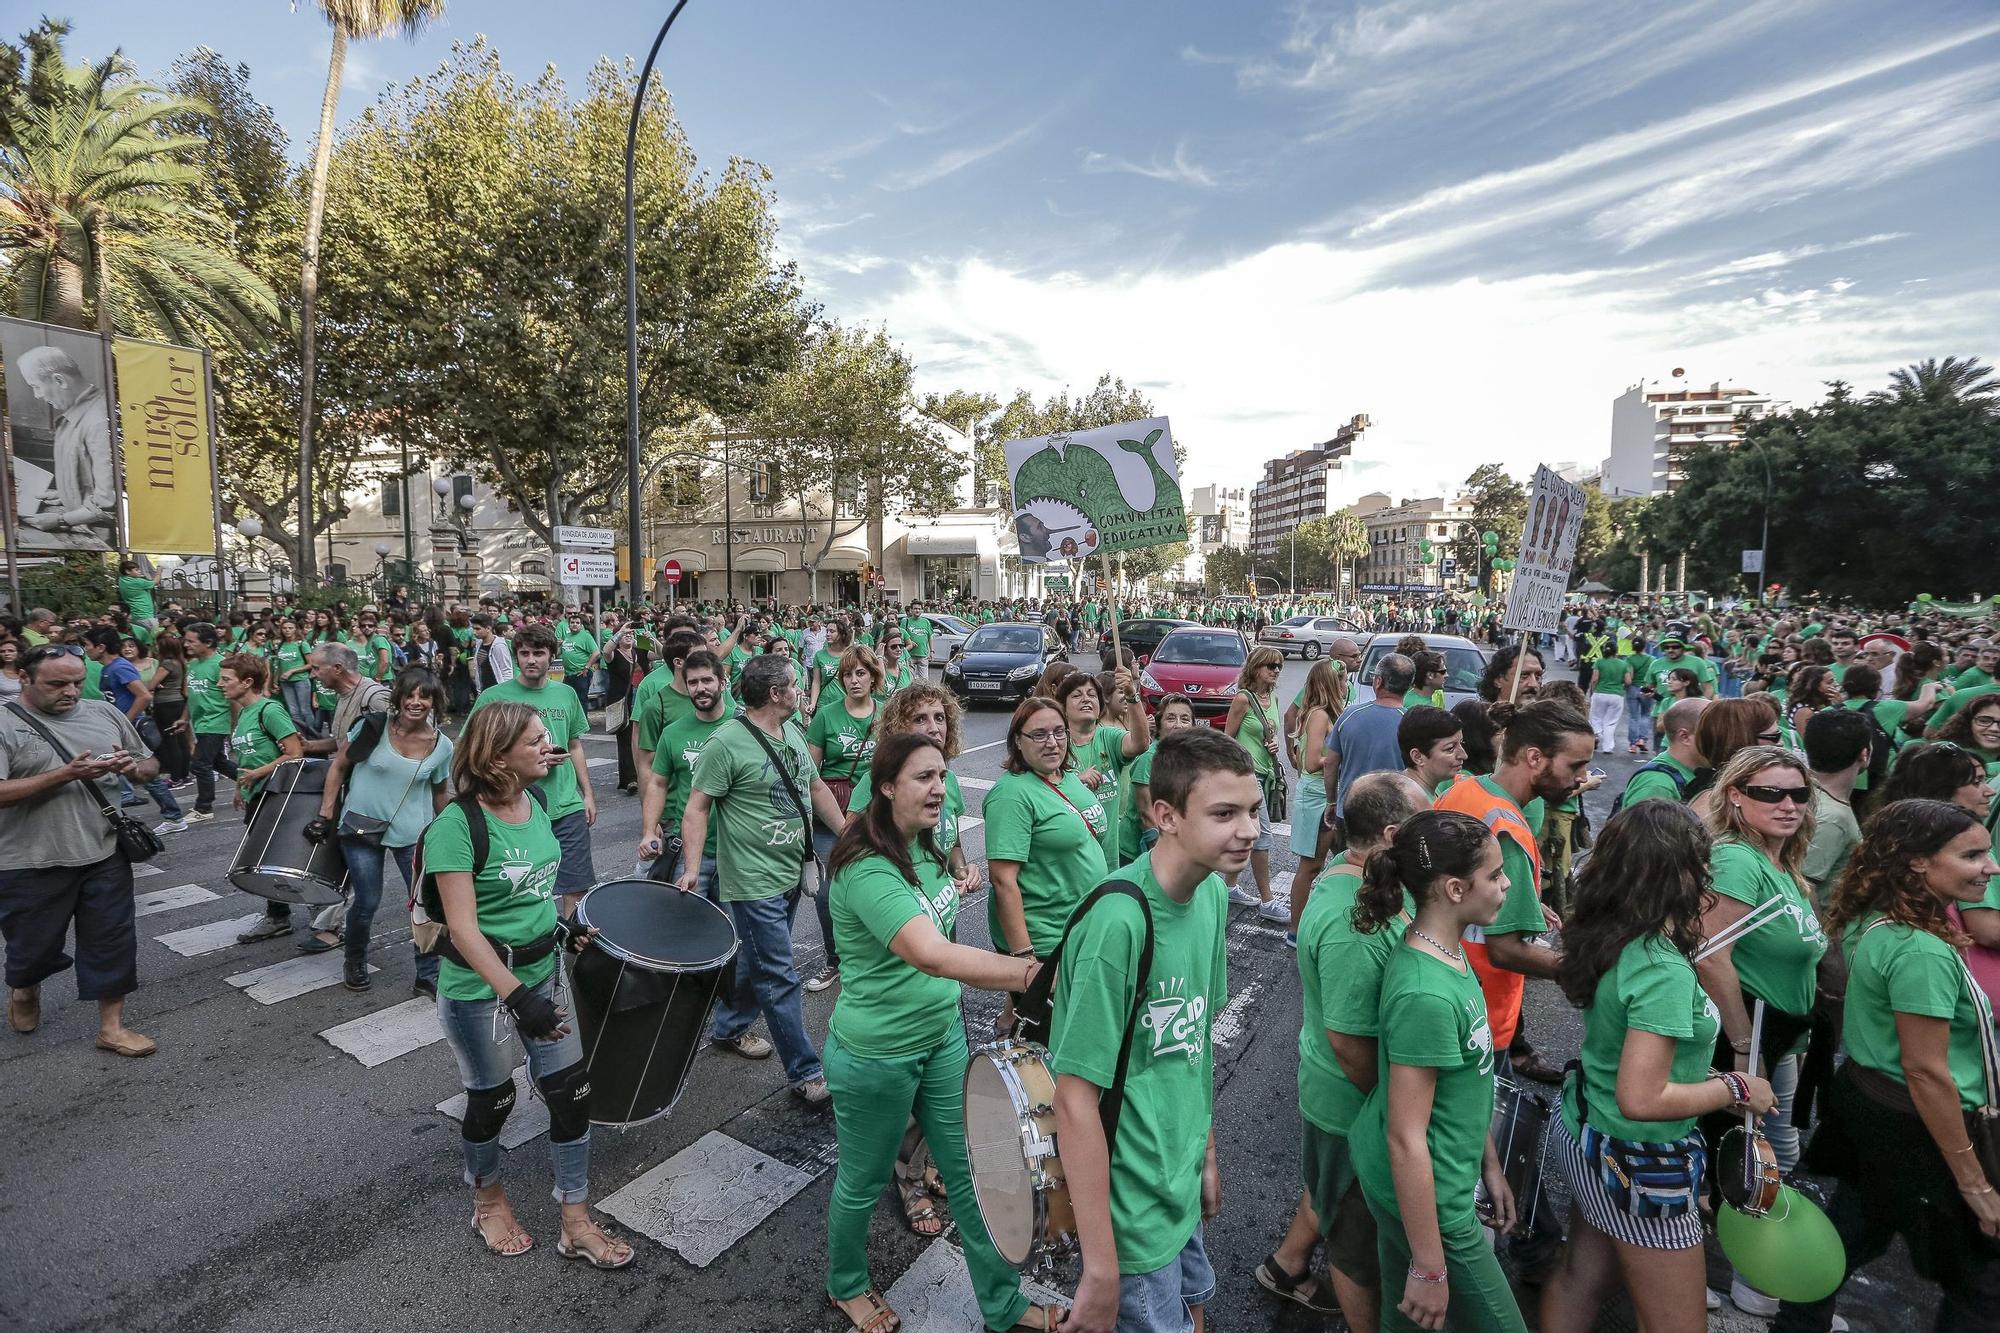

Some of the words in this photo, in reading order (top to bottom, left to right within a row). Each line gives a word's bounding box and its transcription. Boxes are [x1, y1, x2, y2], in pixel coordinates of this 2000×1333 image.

[1099, 506, 1182, 529] COMUNITAT
[561, 530, 581, 538] AVINGUDA
[588, 531, 598, 539] JOAN
[711, 526, 819, 546] RESTAURANT
[1103, 523, 1187, 545] EDUCATIVA
[1443, 559, 1456, 573] P
